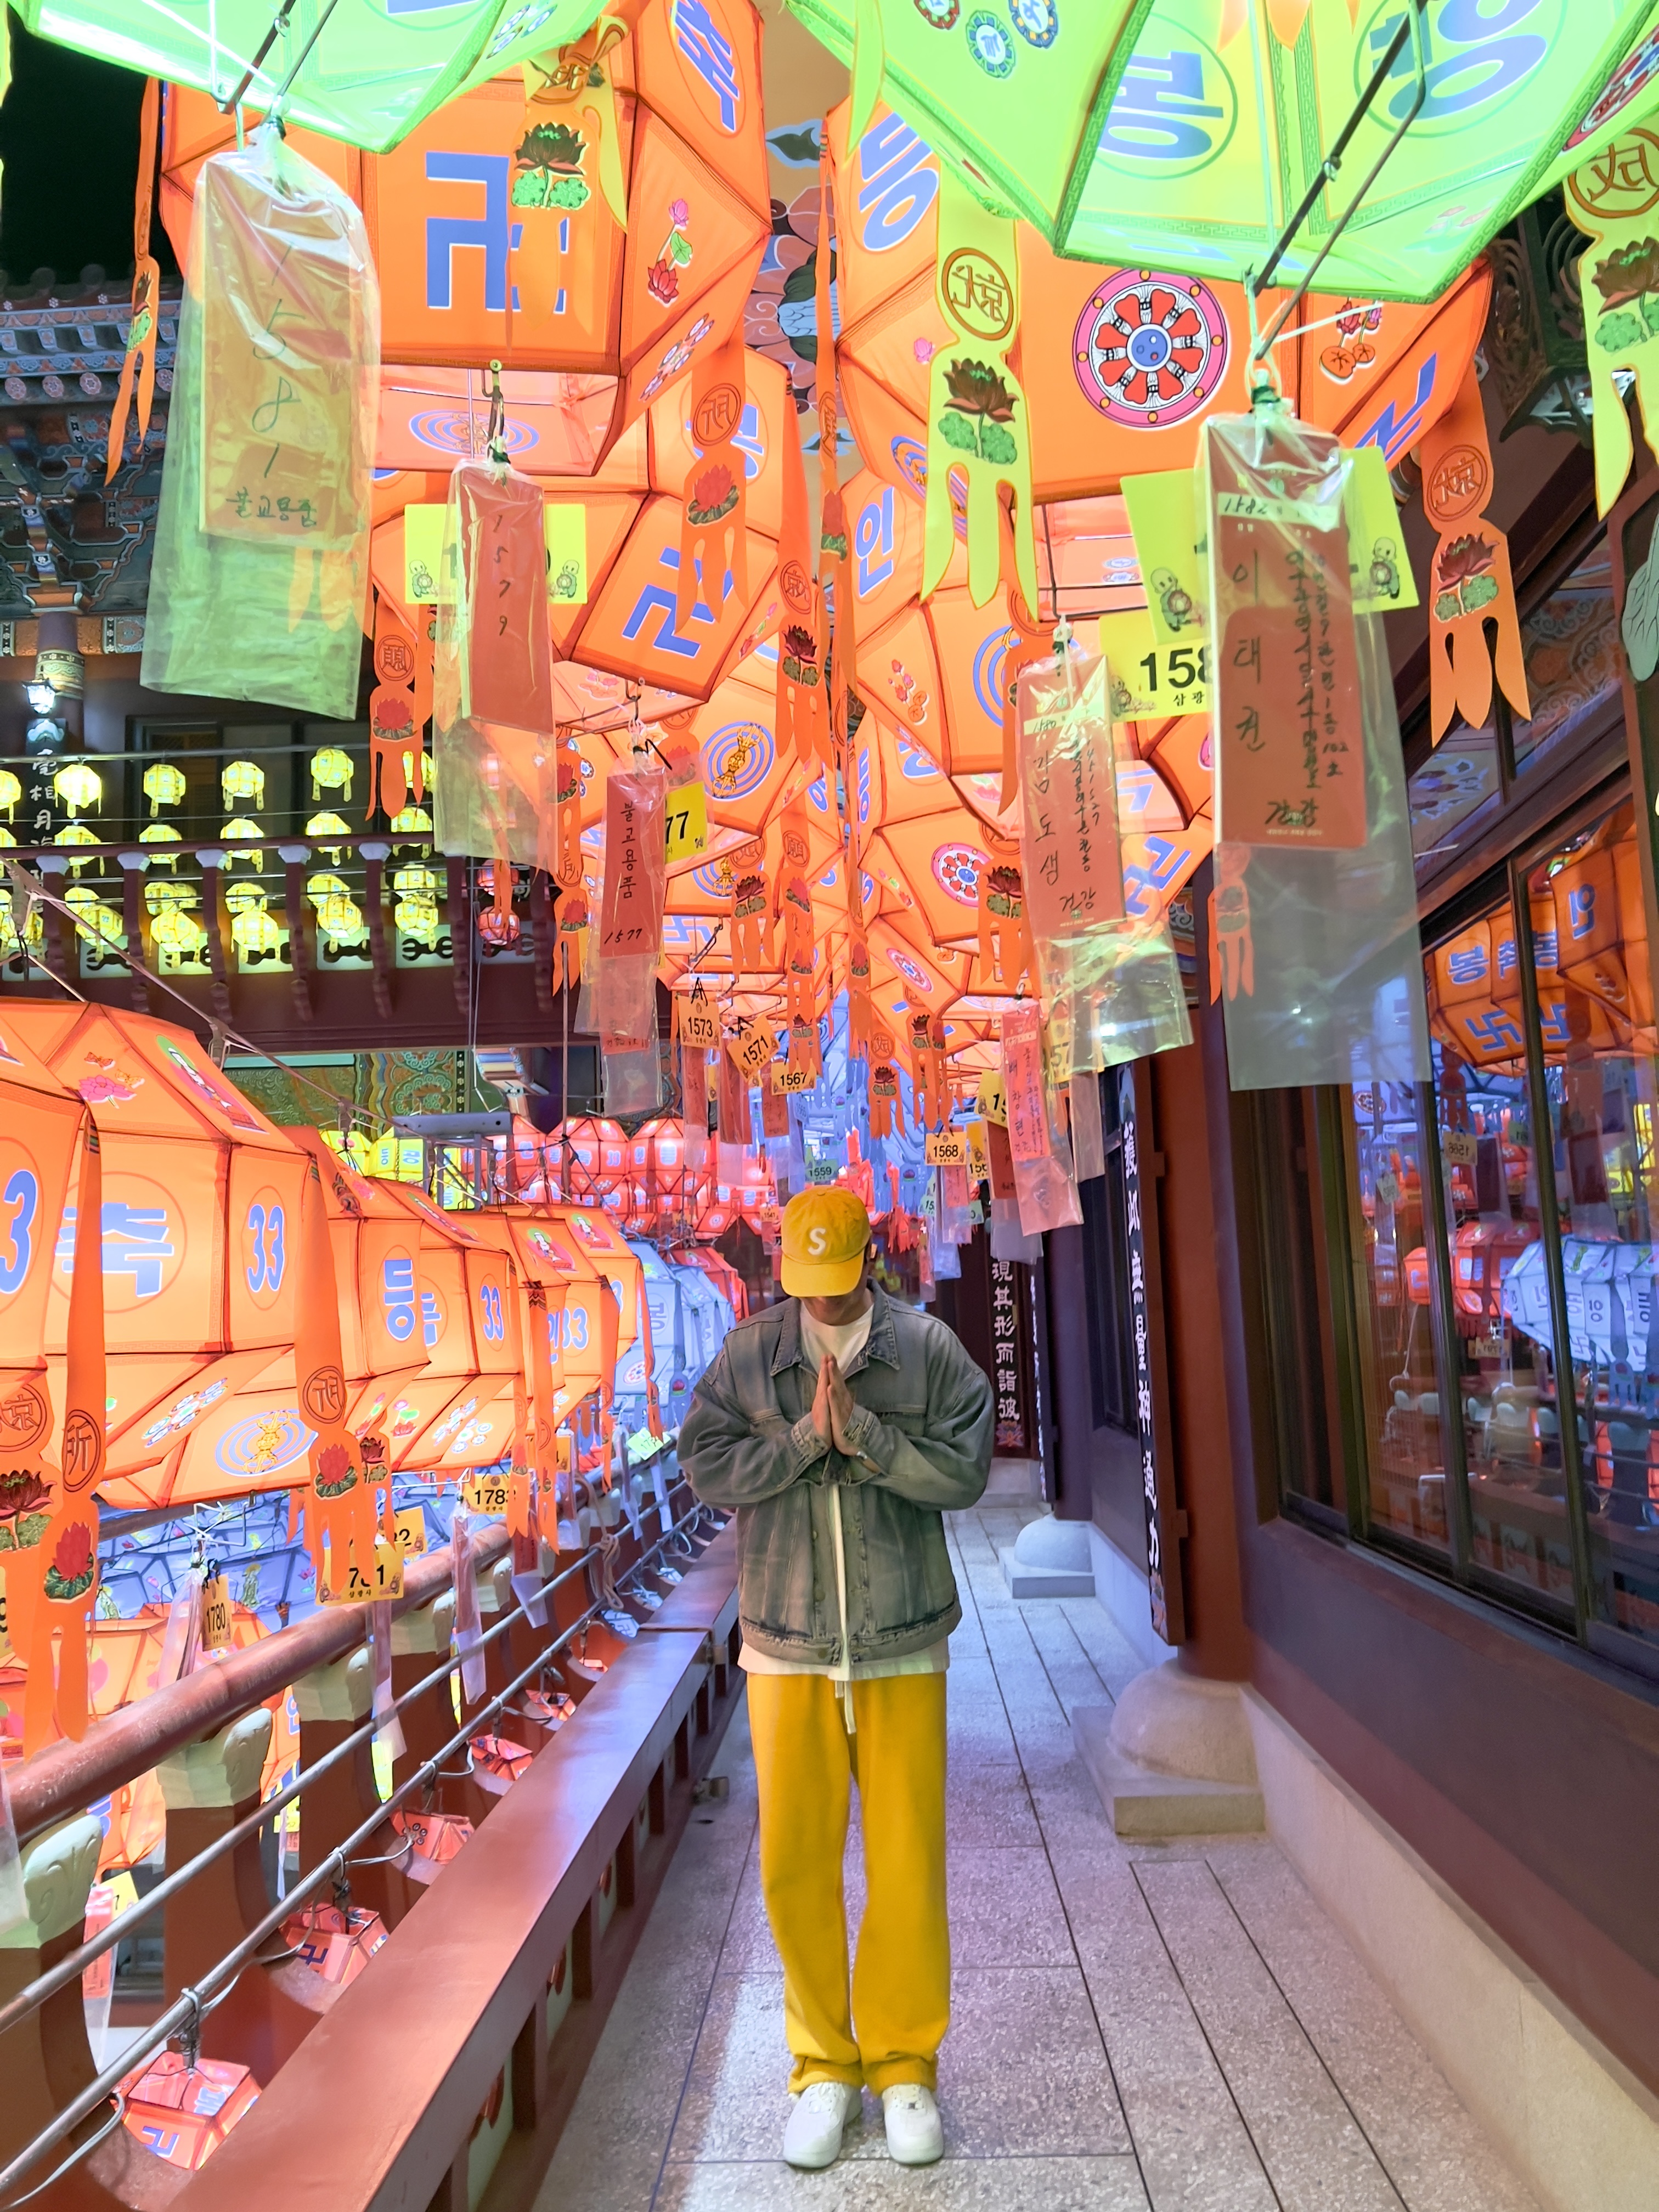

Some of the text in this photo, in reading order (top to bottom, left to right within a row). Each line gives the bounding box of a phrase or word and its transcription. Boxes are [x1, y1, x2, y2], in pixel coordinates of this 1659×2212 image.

[1224, 495, 1267, 515] 1582
[855, 487, 894, 597] 인
[493, 514, 510, 637] 1579
[1033, 719, 1057, 733] 1580
[1059, 887, 1096, 911] 건강
[605, 927, 643, 945] 1577
[687, 1015, 714, 1038] 1573
[742, 1035, 769, 1065] 1571
[780, 1071, 807, 1086] 1567
[933, 1144, 958, 1158] 1568
[808, 1166, 833, 1178] 1559
[247, 1204, 286, 1293] 33
[807, 1227, 827, 1256] S
[383, 1259, 415, 1341] 봉
[481, 1284, 505, 1341] 33
[206, 1602, 225, 1633] 1780
